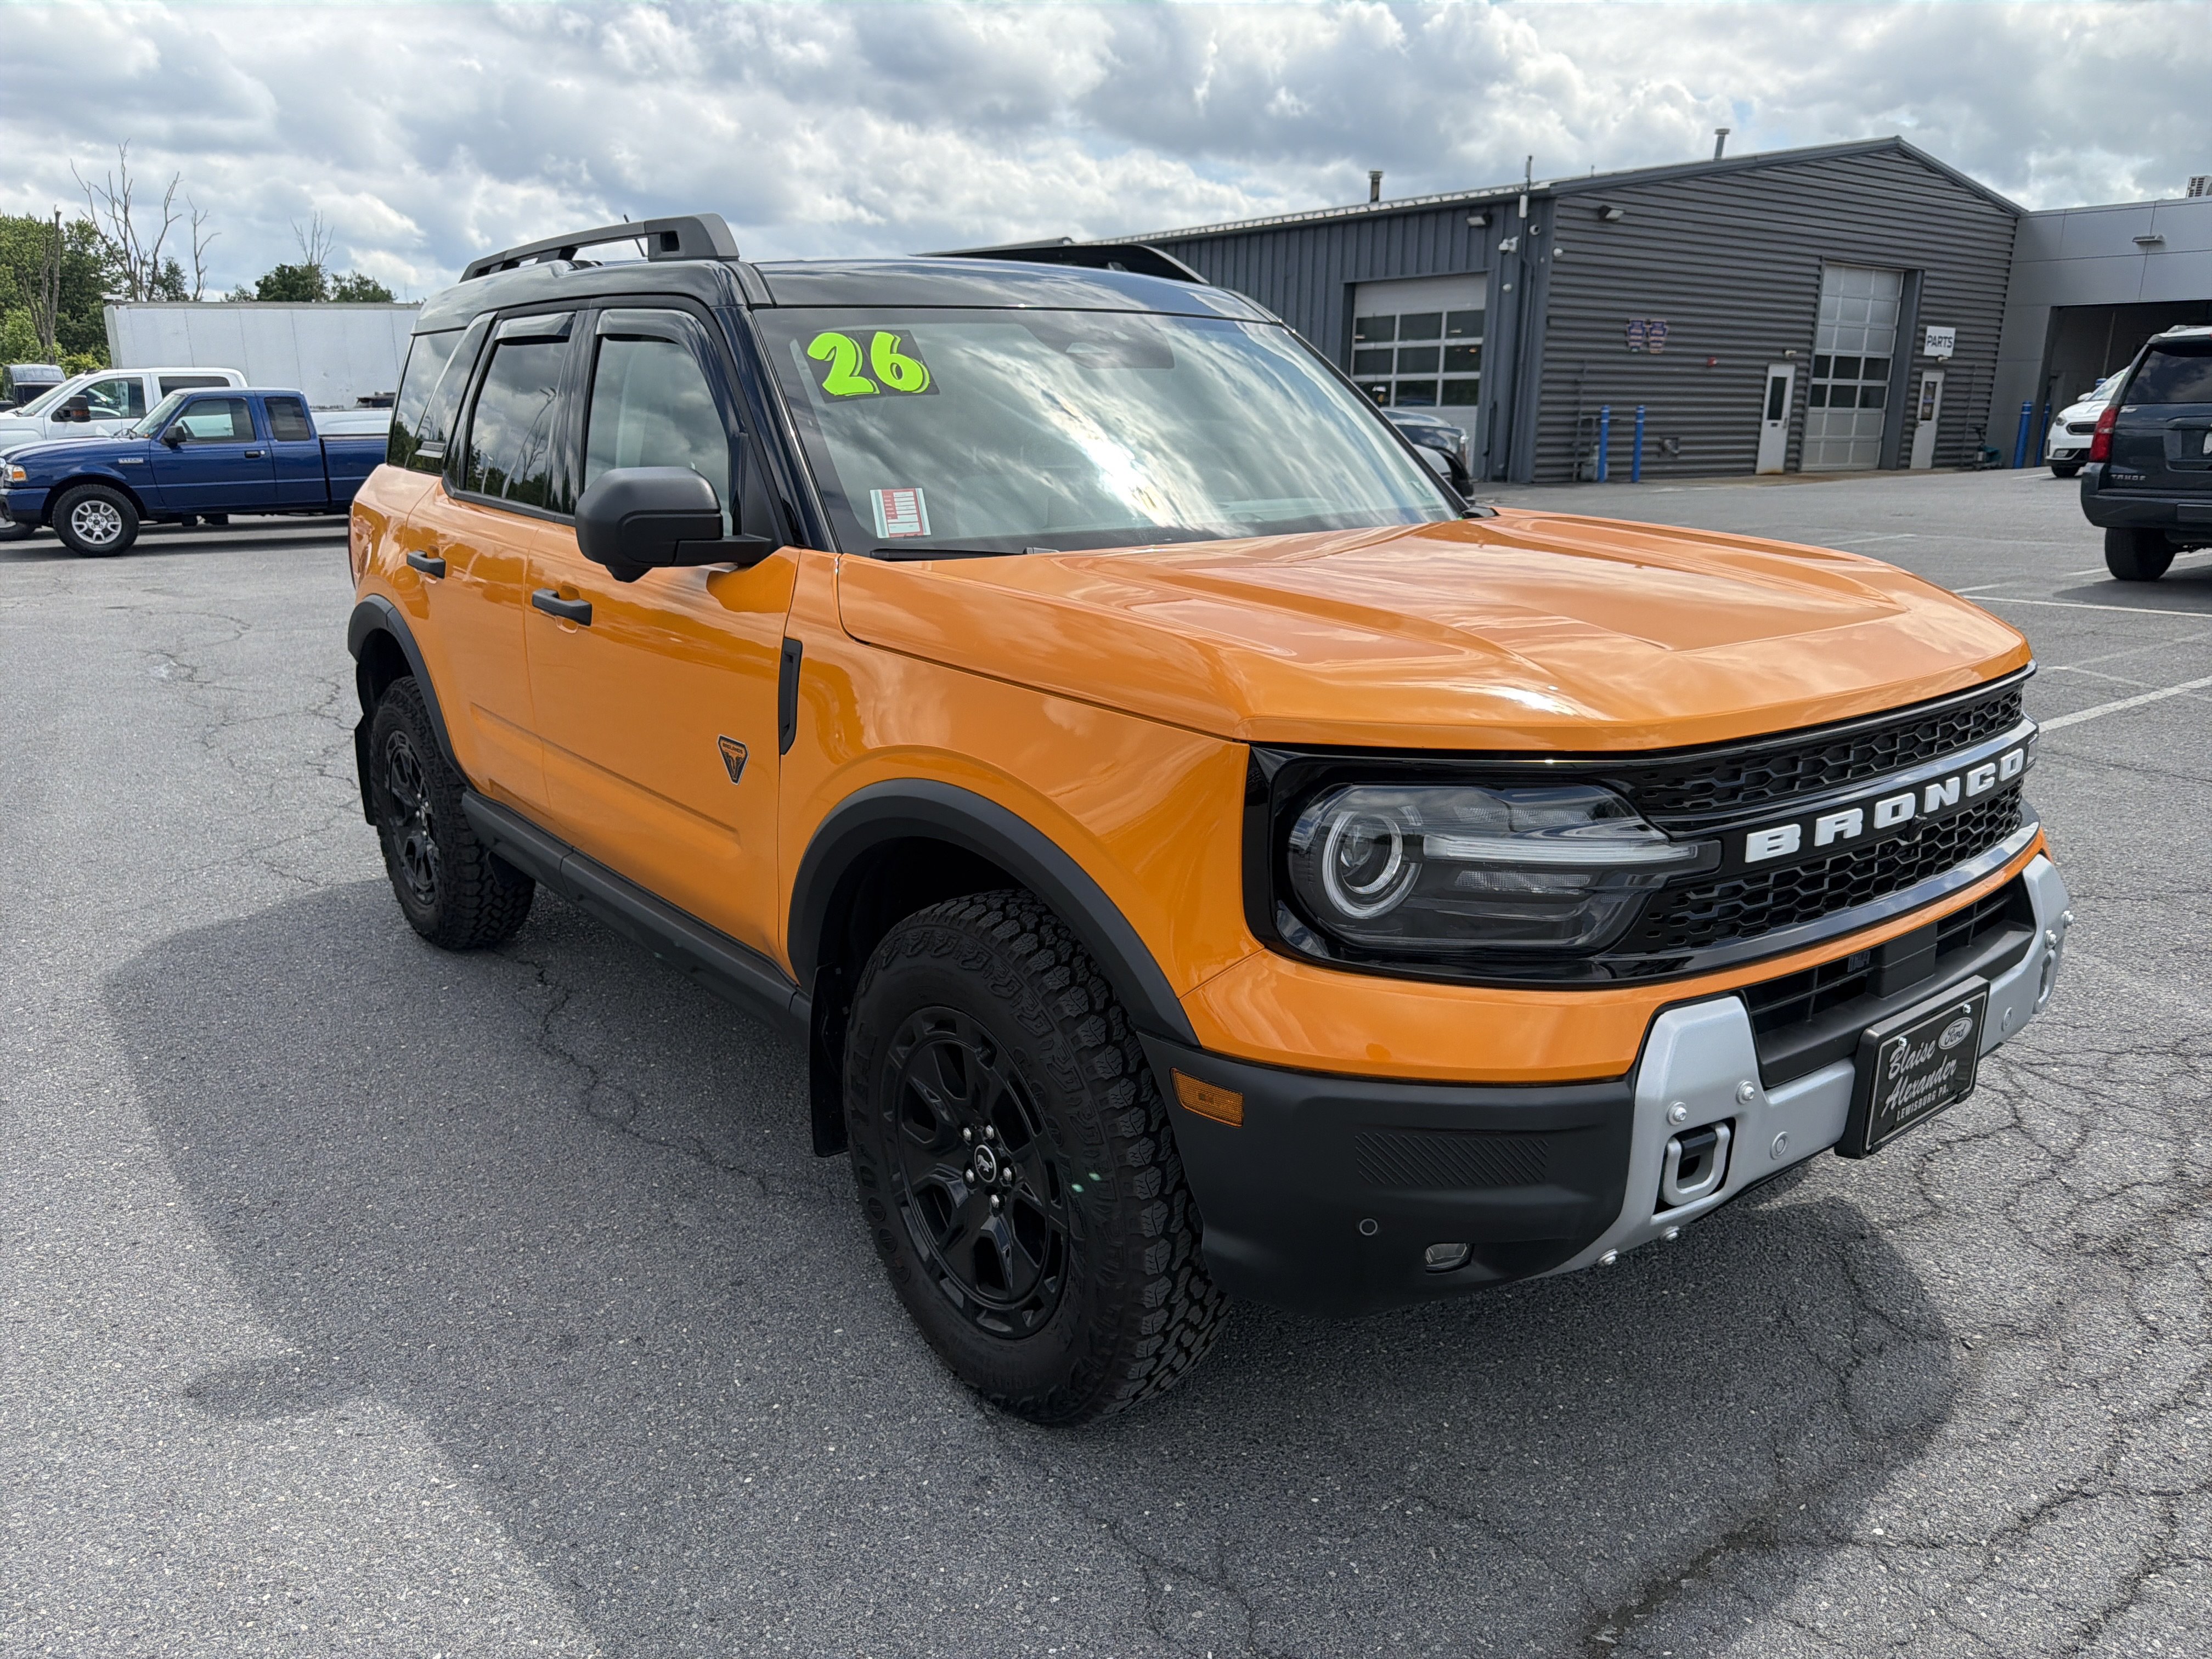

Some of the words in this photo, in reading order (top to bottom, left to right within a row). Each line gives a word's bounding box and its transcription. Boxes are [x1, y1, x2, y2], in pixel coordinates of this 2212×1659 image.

[1927, 335, 1953, 348] PARTS
[808, 332, 930, 396] 26
[1745, 748, 2024, 863] BRONCO
[1944, 1023, 1967, 1046] Ford
[1888, 1040, 1936, 1080] Blaise
[1881, 1054, 1957, 1118] Alexander
[1897, 1090, 1937, 1121] LEWISBURG
